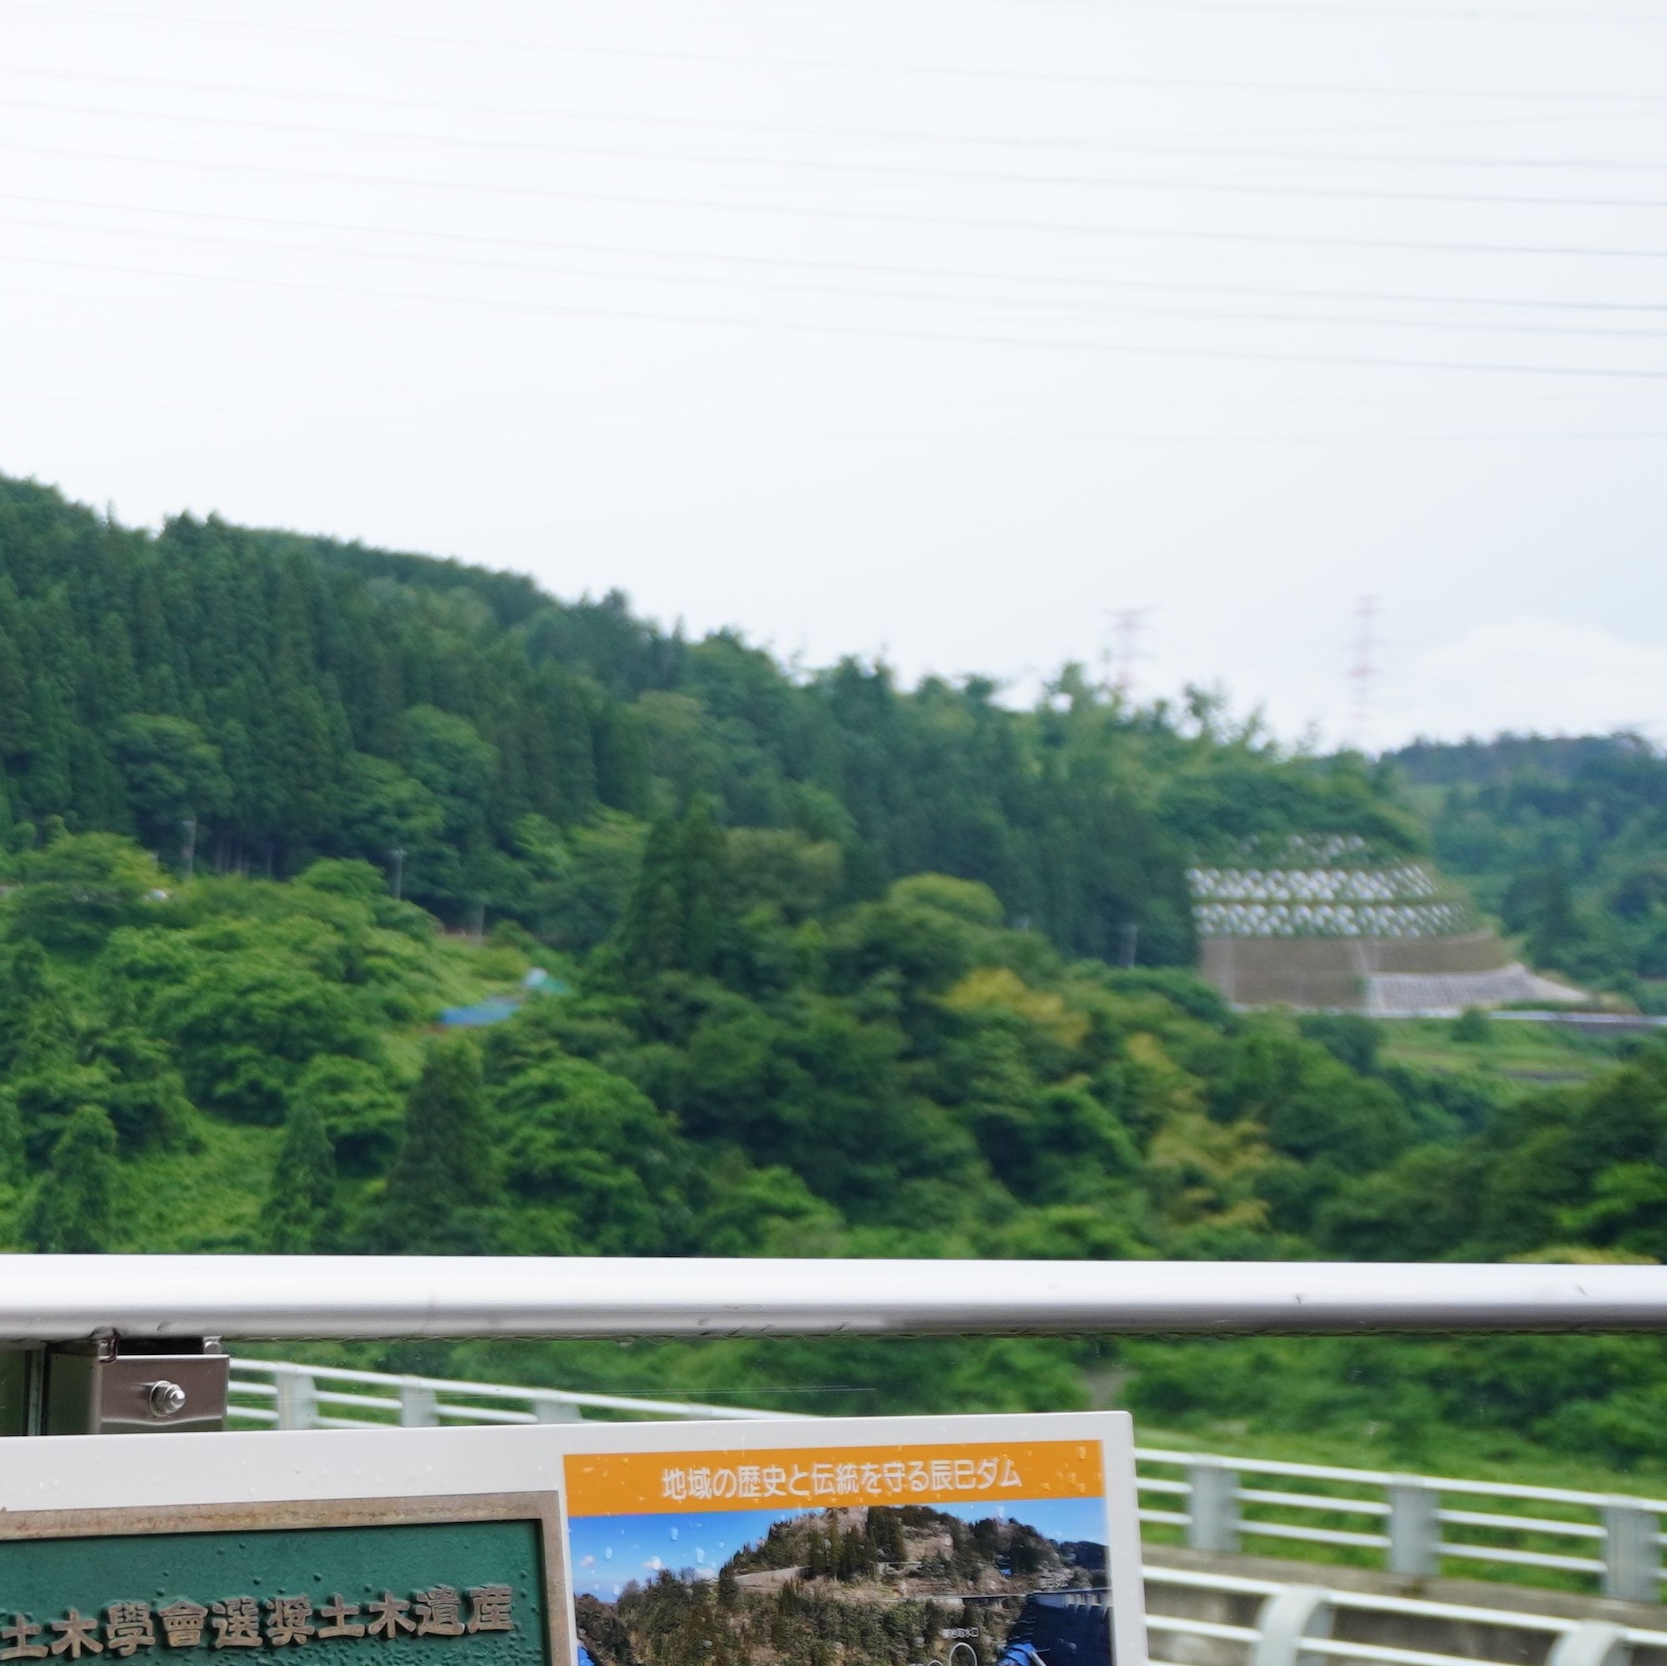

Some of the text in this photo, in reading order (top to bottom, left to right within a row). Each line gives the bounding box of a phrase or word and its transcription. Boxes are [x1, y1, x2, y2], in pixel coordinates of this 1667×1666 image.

[662, 1458, 1022, 1500] 地域の歴史と伝統を守る辰巳ダム
